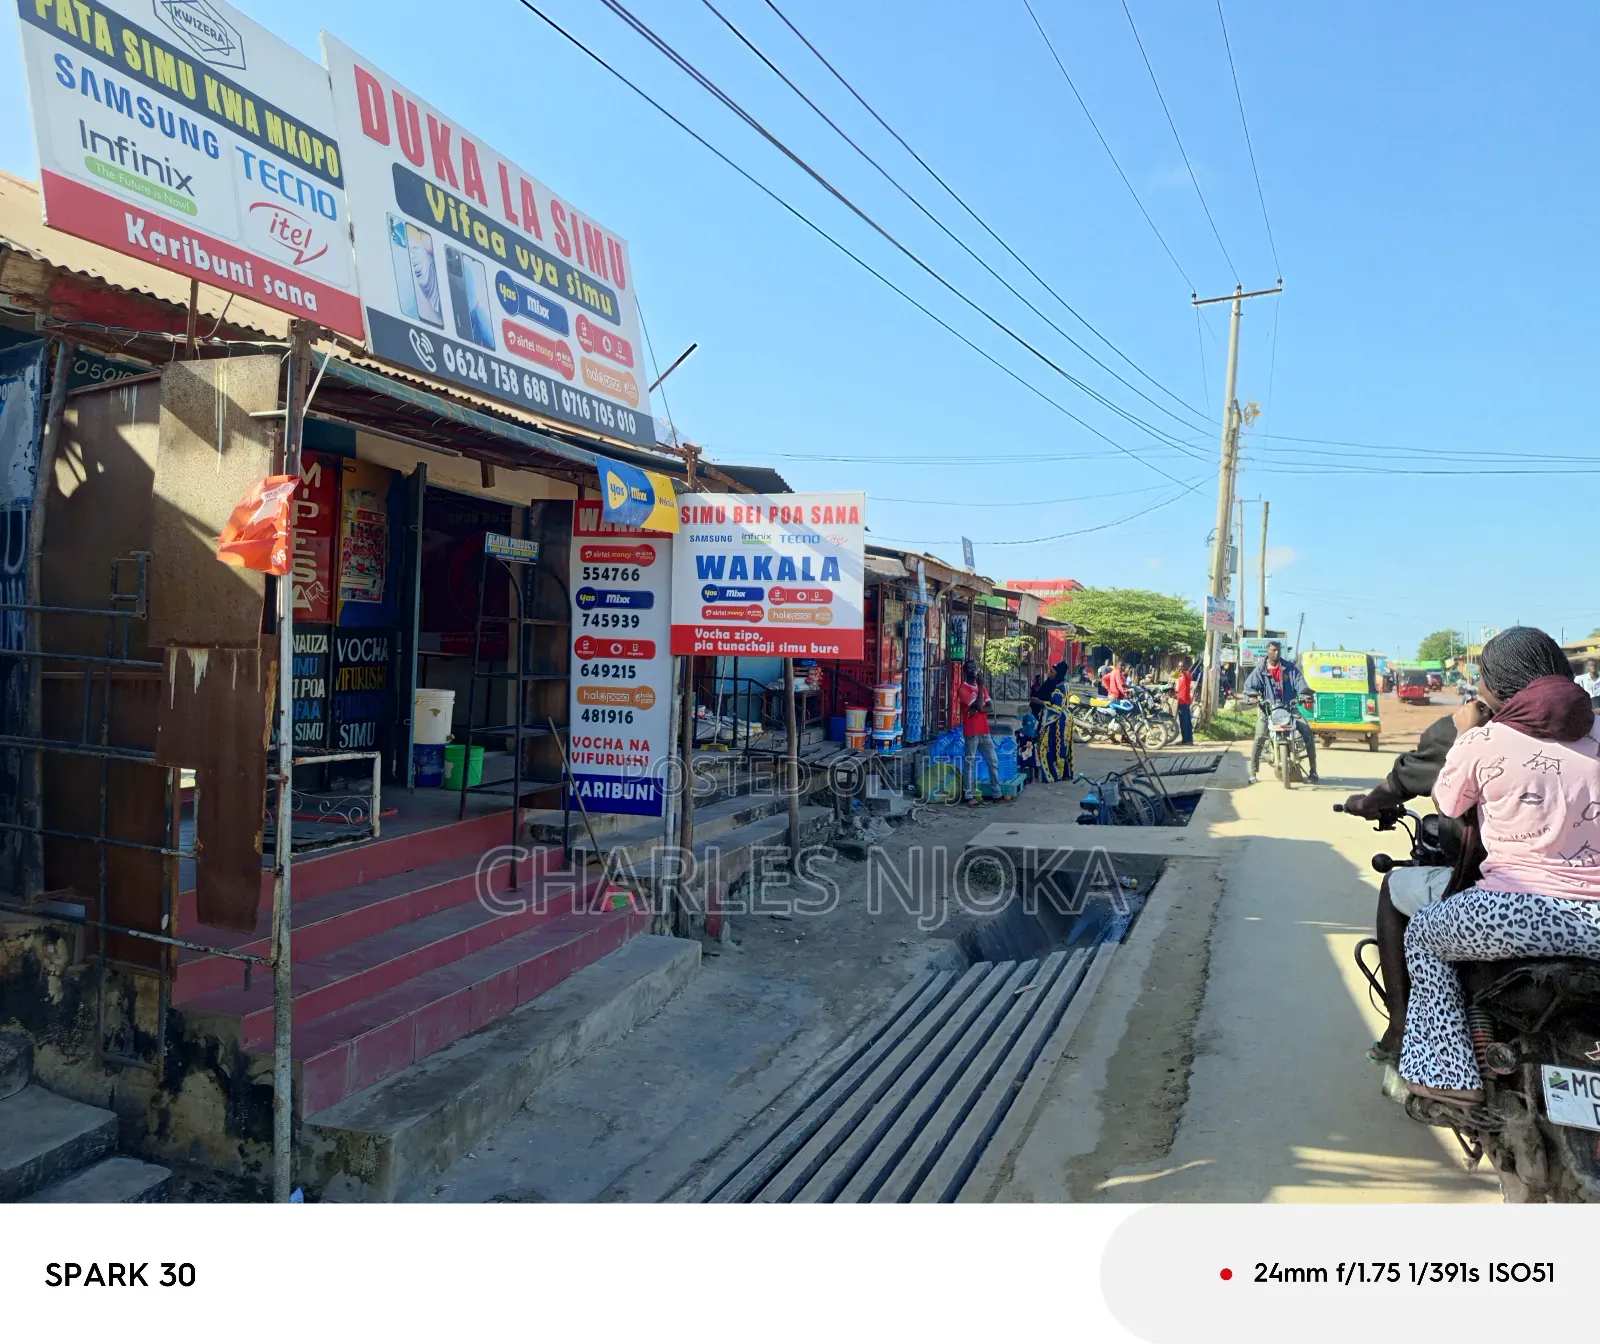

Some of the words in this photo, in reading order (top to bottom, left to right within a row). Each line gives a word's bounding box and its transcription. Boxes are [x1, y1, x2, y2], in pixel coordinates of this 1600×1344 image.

[172, 5, 226, 46] KWIZERA
[54, 52, 220, 160] SAMSUNG
[121, 27, 197, 101] SIMU
[203, 75, 261, 137] KWA
[264, 110, 340, 180] MKOPO
[79, 119, 196, 197] Infinix
[95, 161, 117, 179] The
[118, 170, 152, 196] Future
[152, 185, 162, 200] is
[163, 190, 191, 212] Now!
[235, 145, 338, 222] TECNO
[353, 63, 488, 208] DUKA
[497, 160, 544, 242] LA
[550, 198, 627, 291] SIMU
[269, 212, 313, 250] itel
[424, 182, 507, 260] Vifaa
[515, 244, 559, 288] vya
[566, 271, 613, 317] simu
[124, 212, 255, 288] Karibuni
[263, 274, 318, 312] sana
[499, 283, 517, 302] yas
[517, 335, 535, 352] airtel
[443, 345, 488, 384] 0624
[490, 360, 520, 396] 758
[523, 374, 549, 406] 688
[561, 388, 591, 424] 0716
[592, 400, 615, 428] 705
[617, 409, 637, 436] 010
[681, 505, 726, 525] SIMU
[733, 505, 762, 524] BEI
[769, 505, 804, 524] POA
[811, 505, 860, 525] SANA
[689, 534, 733, 543] SAMSUNG
[779, 534, 821, 544] TECNO
[582, 567, 641, 582] 554766
[695, 555, 841, 582] WAKALA
[580, 593, 596, 605] yas
[704, 589, 718, 598] yas
[582, 613, 640, 628] 745939
[292, 634, 329, 653] NAUZA
[695, 628, 730, 640] Vocha
[735, 629, 764, 642] zipo,
[337, 637, 389, 662] VOCHA
[695, 640, 714, 652] pia
[718, 640, 775, 654] tunachaji
[778, 642, 807, 653] simu
[810, 642, 840, 654] bure
[292, 657, 319, 676] IMU
[580, 663, 637, 679] 649215
[294, 700, 321, 719] FAA
[581, 708, 634, 724] 481916
[295, 722, 324, 741] SIMU
[339, 721, 376, 748] SIMU
[572, 736, 624, 751] VOCHA
[629, 739, 651, 752] NA
[571, 752, 649, 767] VIFURUSHI
